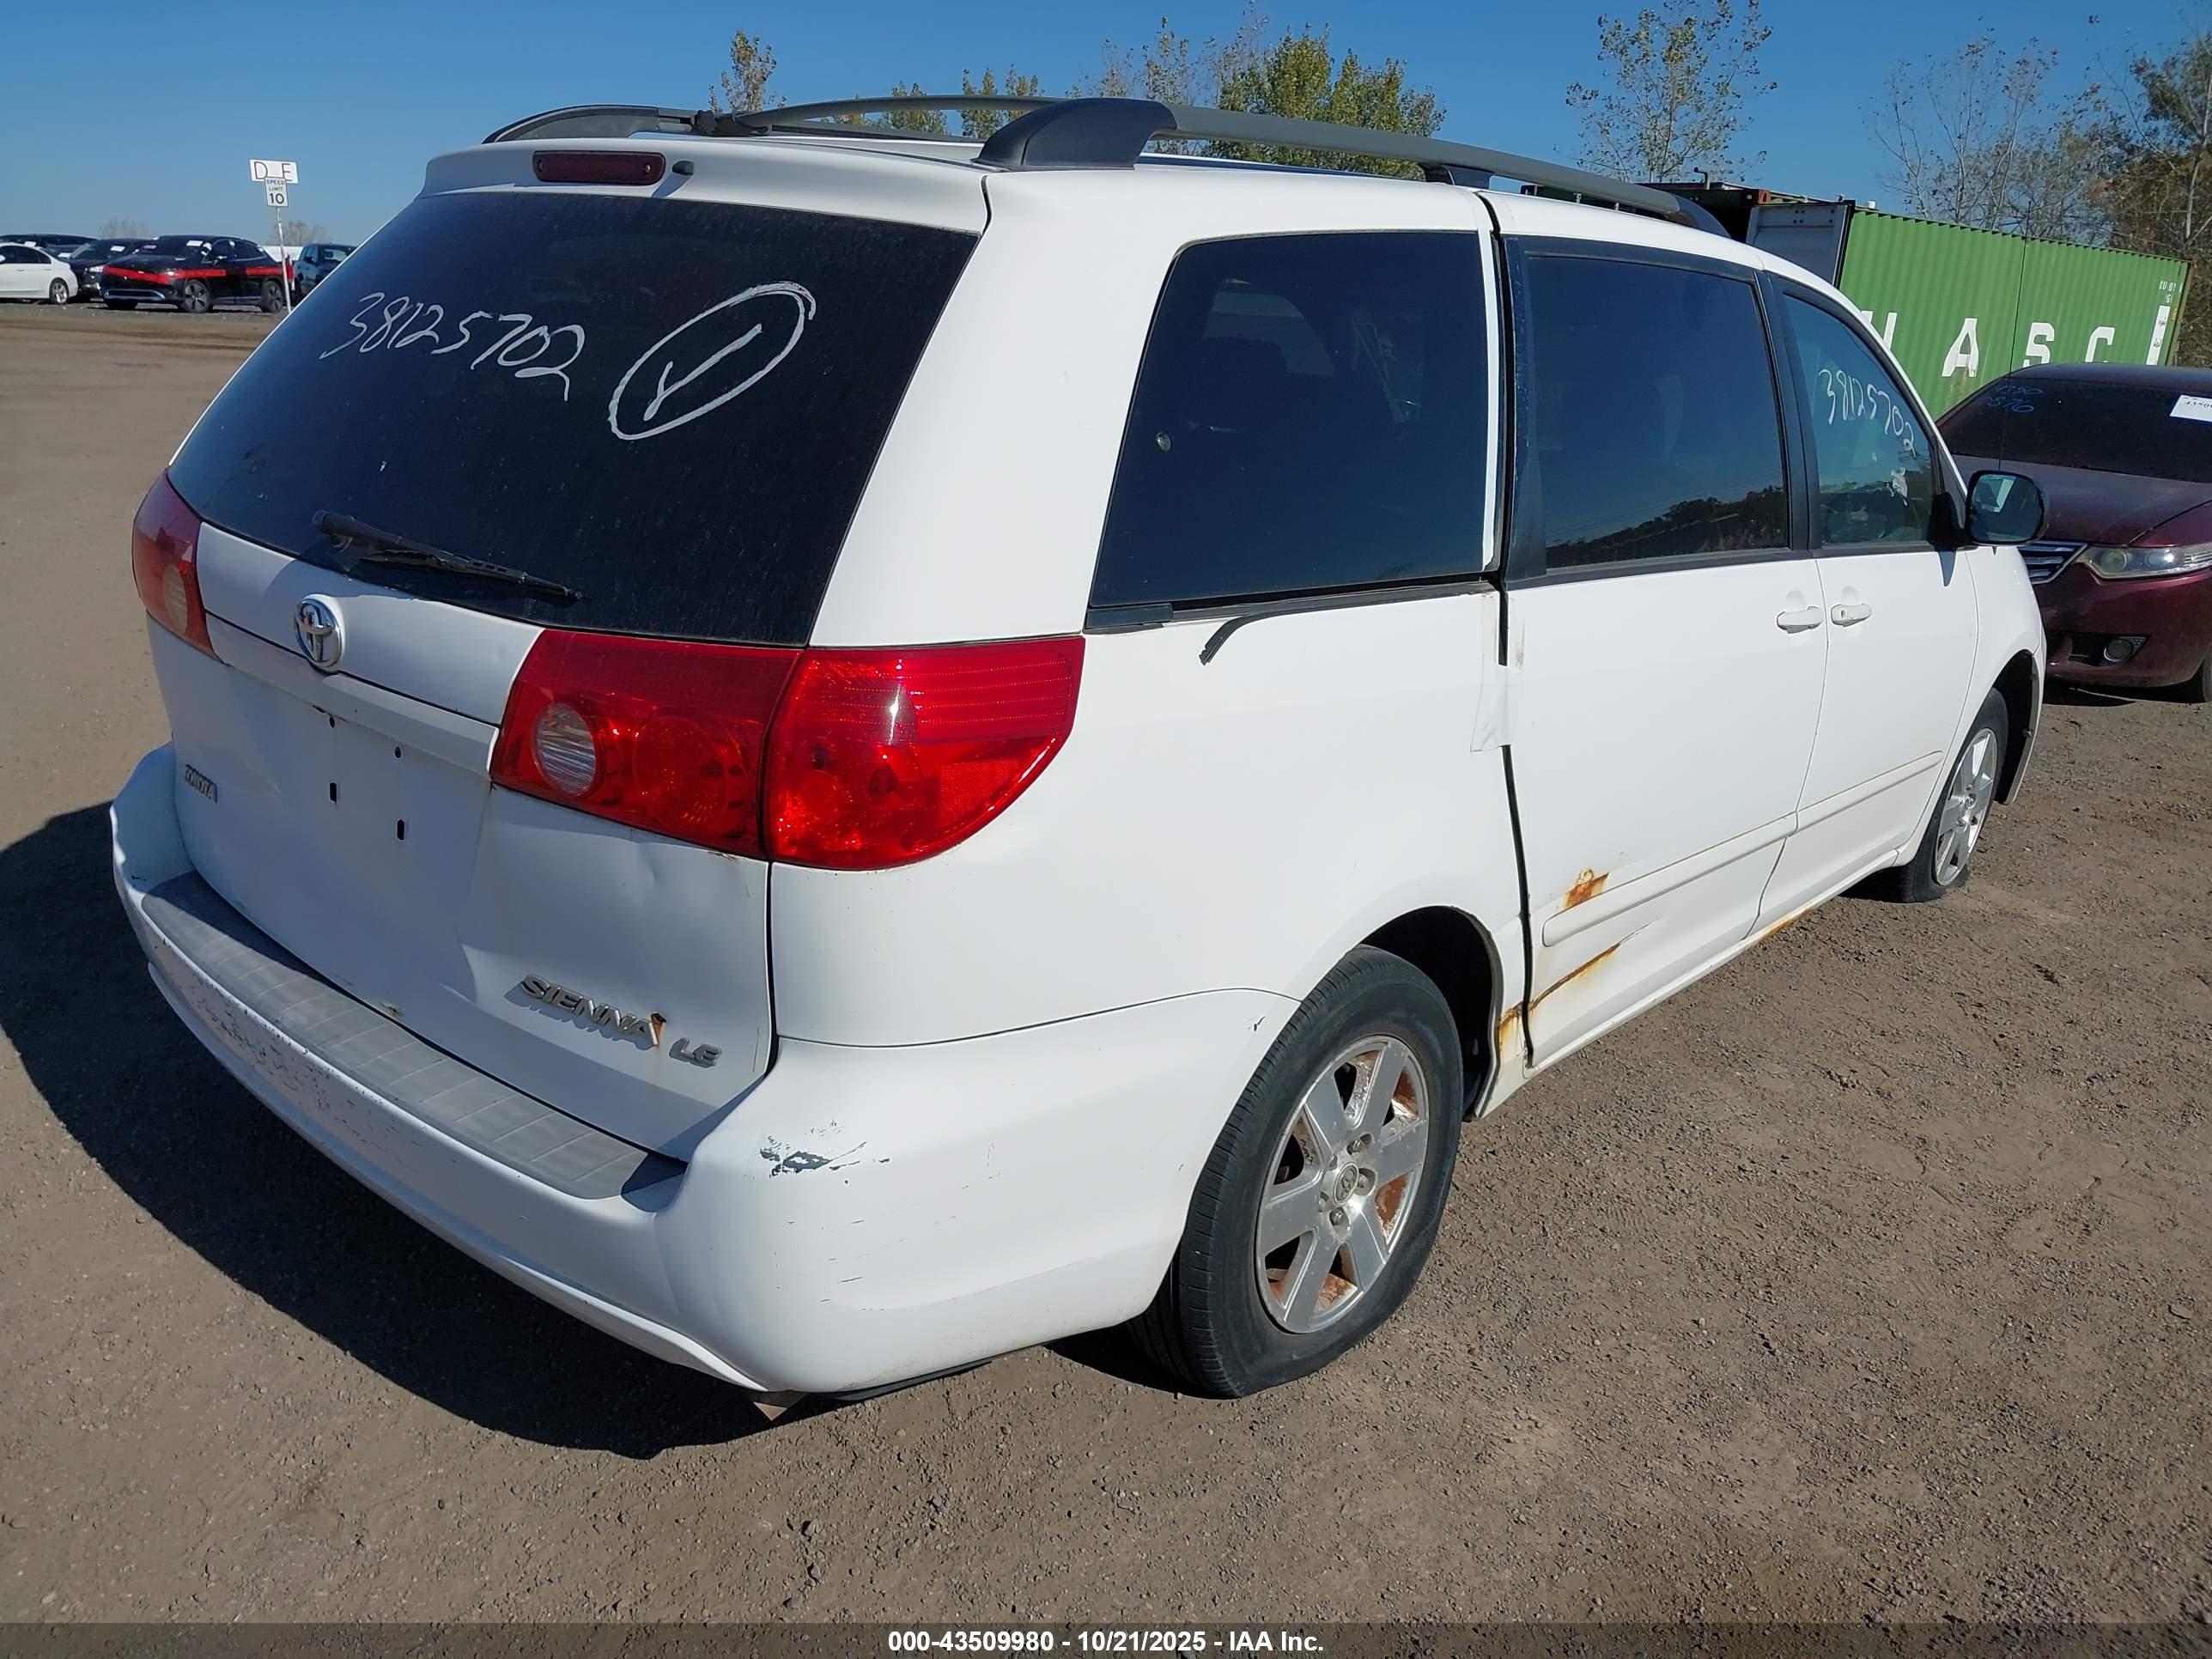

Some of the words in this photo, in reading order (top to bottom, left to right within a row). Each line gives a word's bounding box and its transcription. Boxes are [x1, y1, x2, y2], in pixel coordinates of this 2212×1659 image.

[254, 161, 268, 179] D
[270, 192, 285, 204] 10
[319, 292, 586, 402] 38125702
[1818, 368, 1917, 459] 38125702
[520, 974, 659, 1047] SIENNA
[669, 1037, 723, 1068] LE
